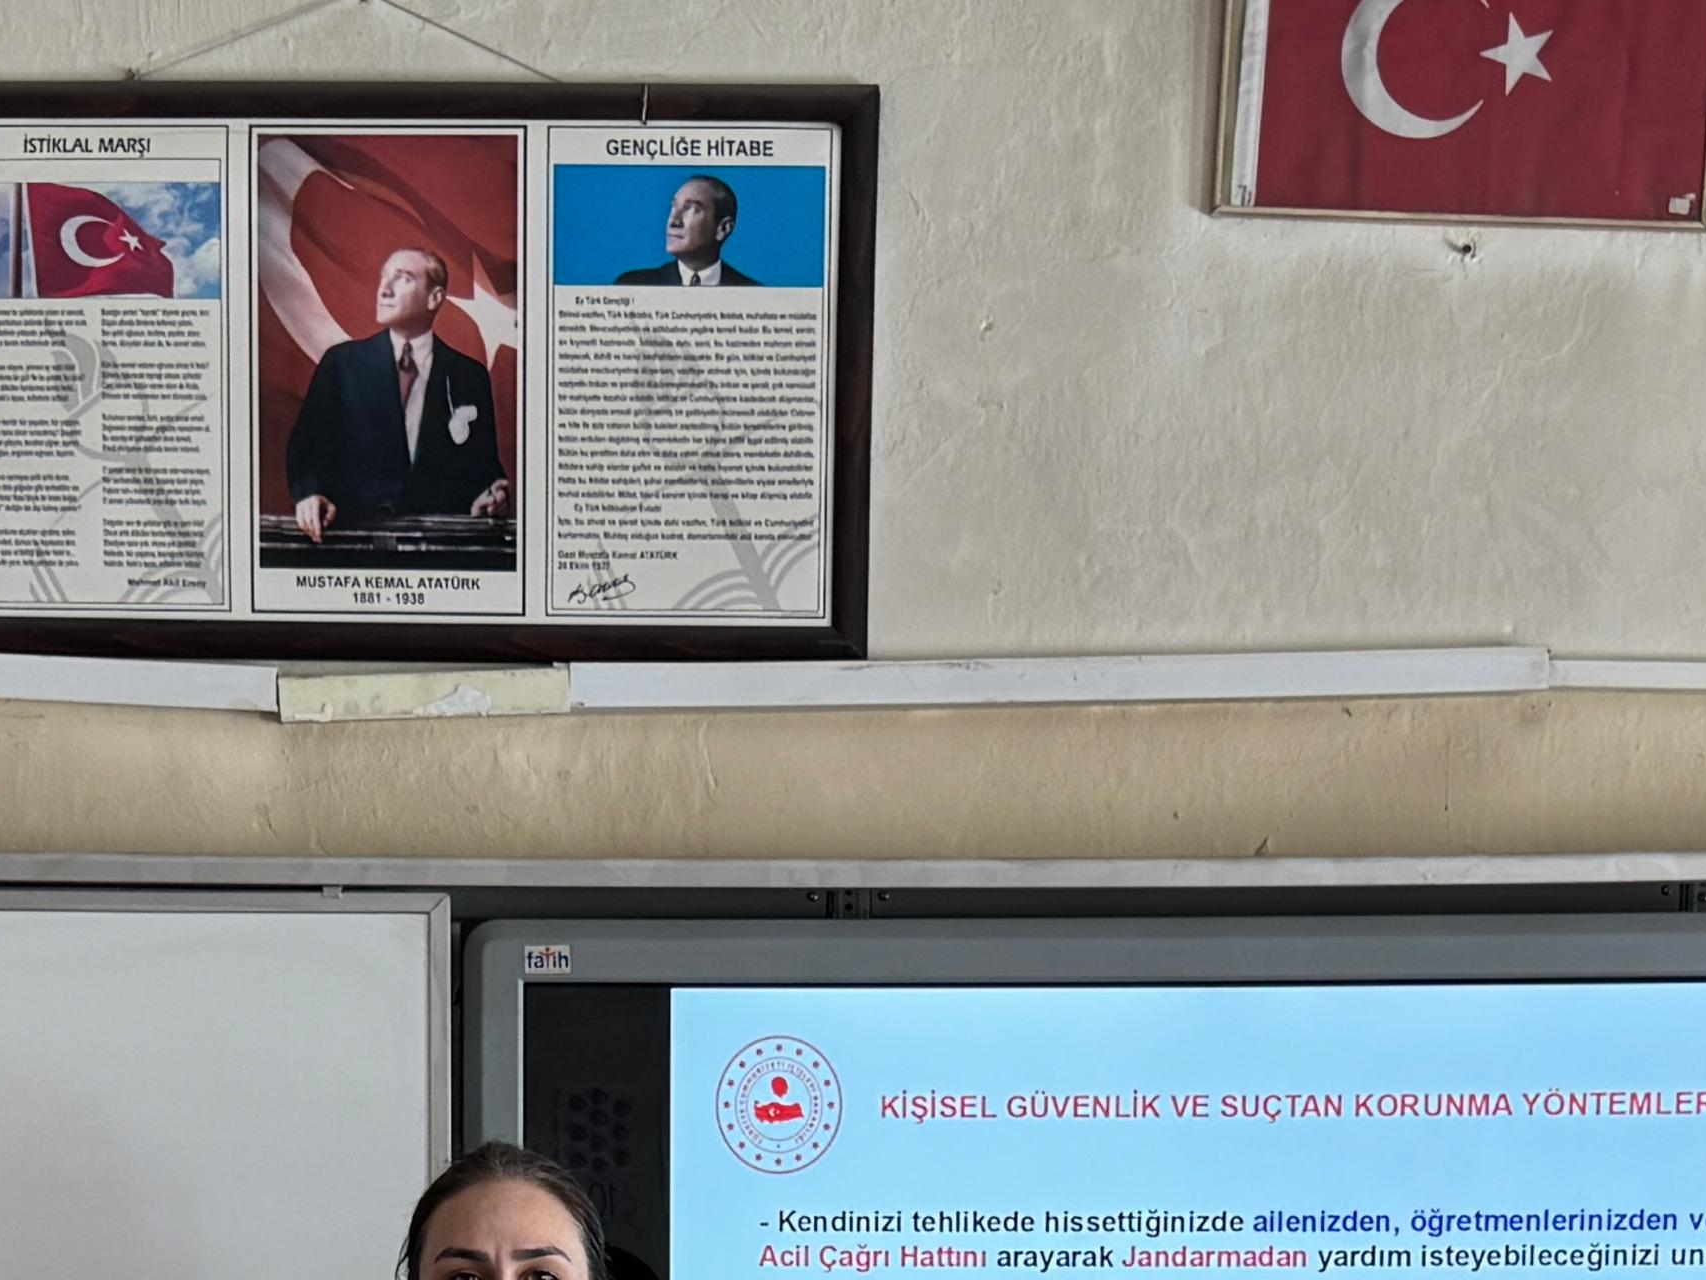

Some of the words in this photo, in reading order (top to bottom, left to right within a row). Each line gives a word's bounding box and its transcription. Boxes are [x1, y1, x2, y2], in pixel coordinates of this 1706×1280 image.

[23, 133, 93, 154] İSTİKLAL
[99, 137, 151, 158] MARŞI
[606, 136, 701, 160] GENÇLİĞE
[707, 136, 774, 157] HİTABE
[296, 576, 361, 589] MUSTAFA
[365, 577, 413, 589] KEMAL
[417, 577, 481, 590] ATATÜRK
[353, 592, 381, 604] 1881
[396, 593, 425, 605] 1938
[881, 1090, 997, 1123] KİŞİSEL
[1007, 1090, 1161, 1120] GÜVENLİK
[1172, 1094, 1209, 1119] VE
[1221, 1093, 1343, 1124] SUÇTAN
[1354, 1092, 1513, 1118] KORUNMA
[779, 1210, 903, 1235] Kendinizi
[912, 1210, 1035, 1234] tehlikede
[1045, 1209, 1244, 1238] hissettiğinizde
[1253, 1209, 1401, 1236] ailenizden,
[1410, 1208, 1679, 1237] öğretmenlerinizden
[760, 1245, 810, 1269] Acil
[819, 1244, 891, 1274] Çağrı
[900, 1245, 988, 1269] Hattını
[997, 1246, 1114, 1274] arayarak
[1122, 1244, 1308, 1269] Jandarmadan
[1318, 1245, 1411, 1273] yardım
[1421, 1243, 1660, 1273] isteyebileceğinizi
